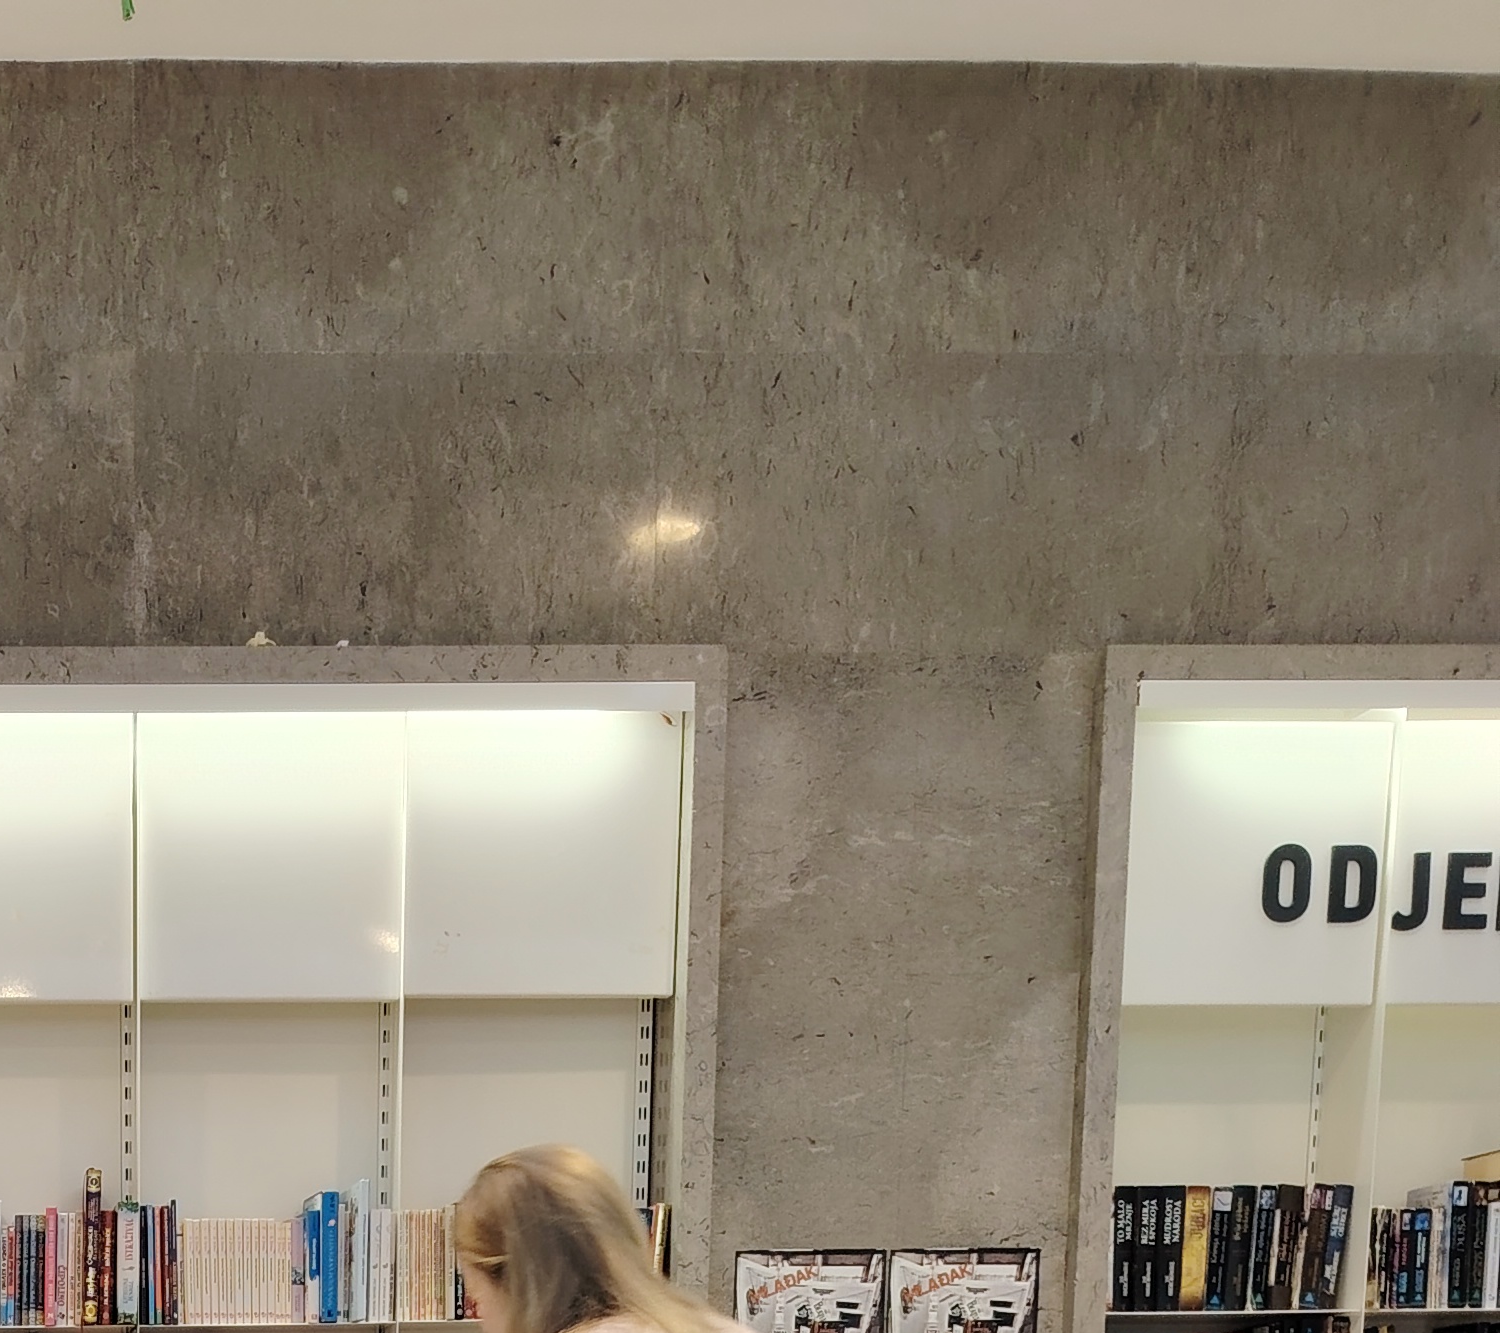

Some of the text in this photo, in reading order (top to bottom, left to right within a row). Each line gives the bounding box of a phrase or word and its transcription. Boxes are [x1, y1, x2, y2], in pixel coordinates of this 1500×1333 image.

[1262, 843, 1500, 931] ODJE
[1116, 1199, 1126, 1245] TO MALO
[1162, 1197, 1173, 1245] MUDROST
[1171, 1199, 1181, 1242] NARODA
